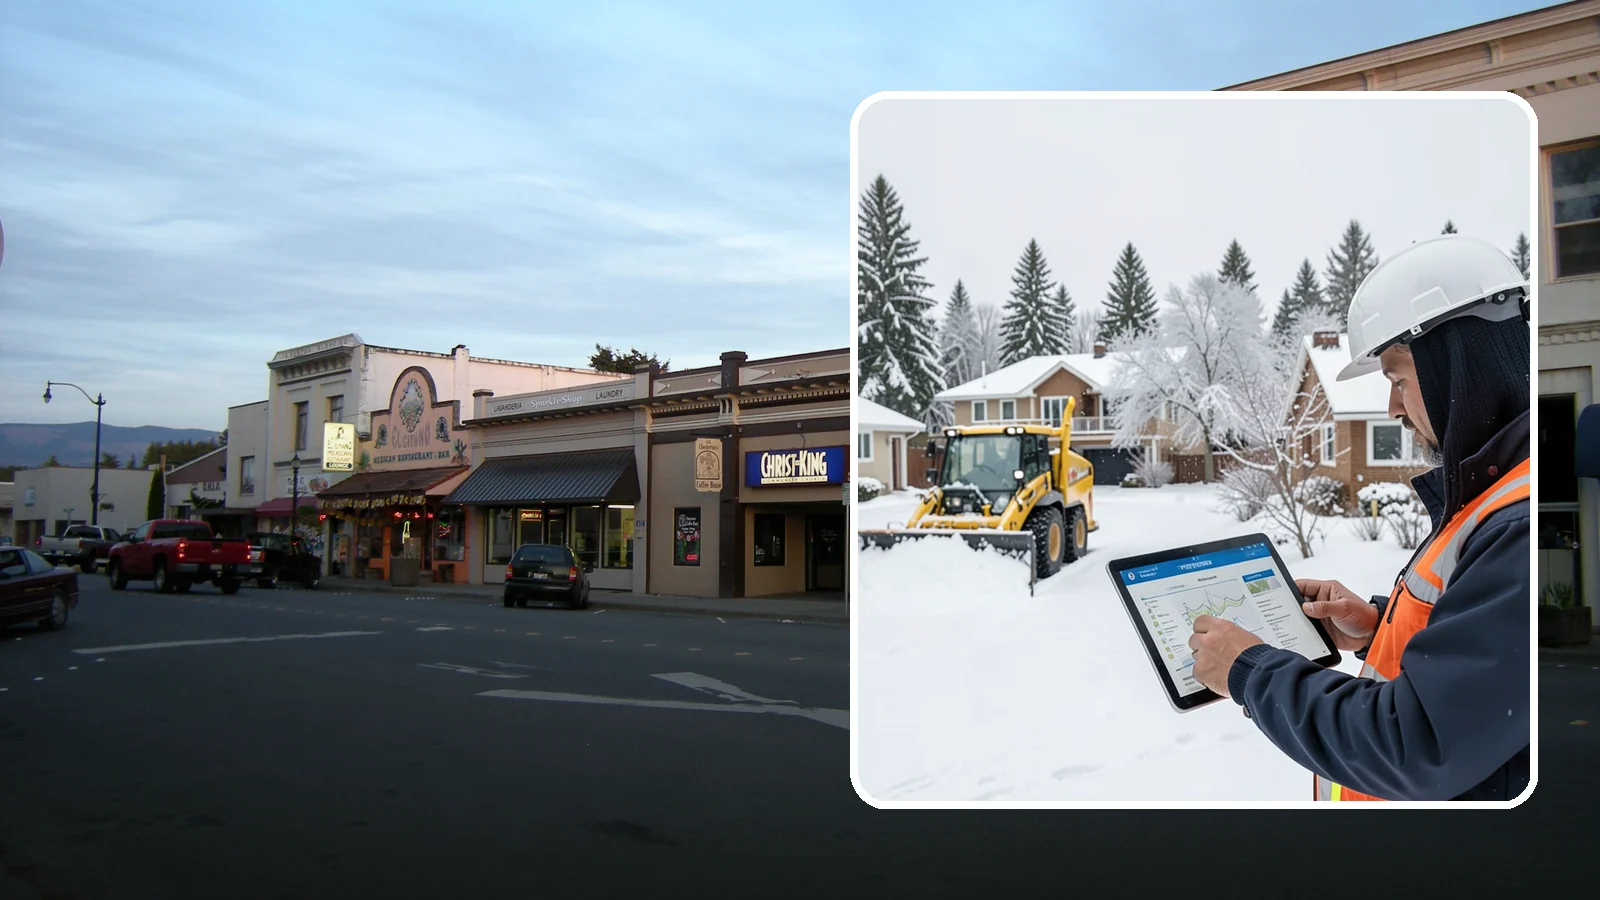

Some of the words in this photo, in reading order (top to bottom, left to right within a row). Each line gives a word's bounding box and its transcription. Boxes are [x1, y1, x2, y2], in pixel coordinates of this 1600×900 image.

[595, 389, 623, 399] LAUNDRY
[493, 402, 523, 412] LAVANDERIA
[373, 455, 396, 464] MEXICAN
[397, 451, 433, 462] RESTAURANT
[437, 450, 450, 458] BAR
[761, 452, 797, 477] CHRIST
[799, 450, 827, 476] KING
